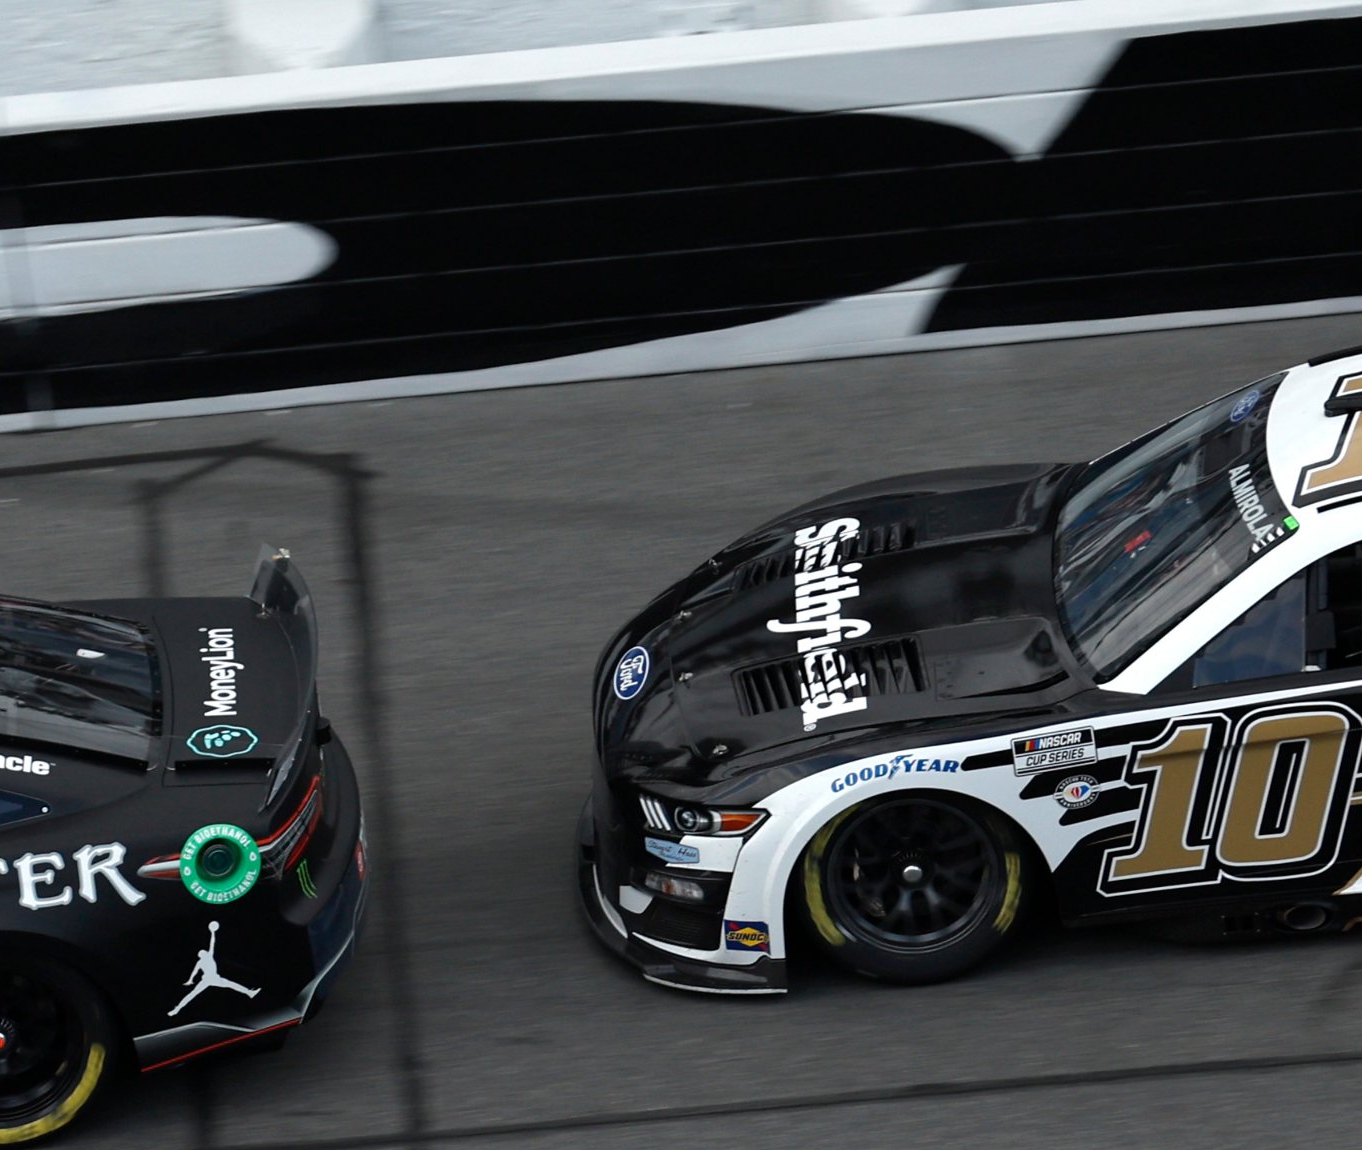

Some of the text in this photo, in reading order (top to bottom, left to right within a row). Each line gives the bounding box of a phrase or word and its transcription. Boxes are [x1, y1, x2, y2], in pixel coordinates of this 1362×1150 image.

[1228, 463, 1274, 541] ALMIROLA
[199, 627, 245, 717] MoneyLion
[1026, 748, 1085, 766] CUP SERIES
[1039, 732, 1082, 749] NASCAR
[831, 754, 959, 793] GOODYEAR
